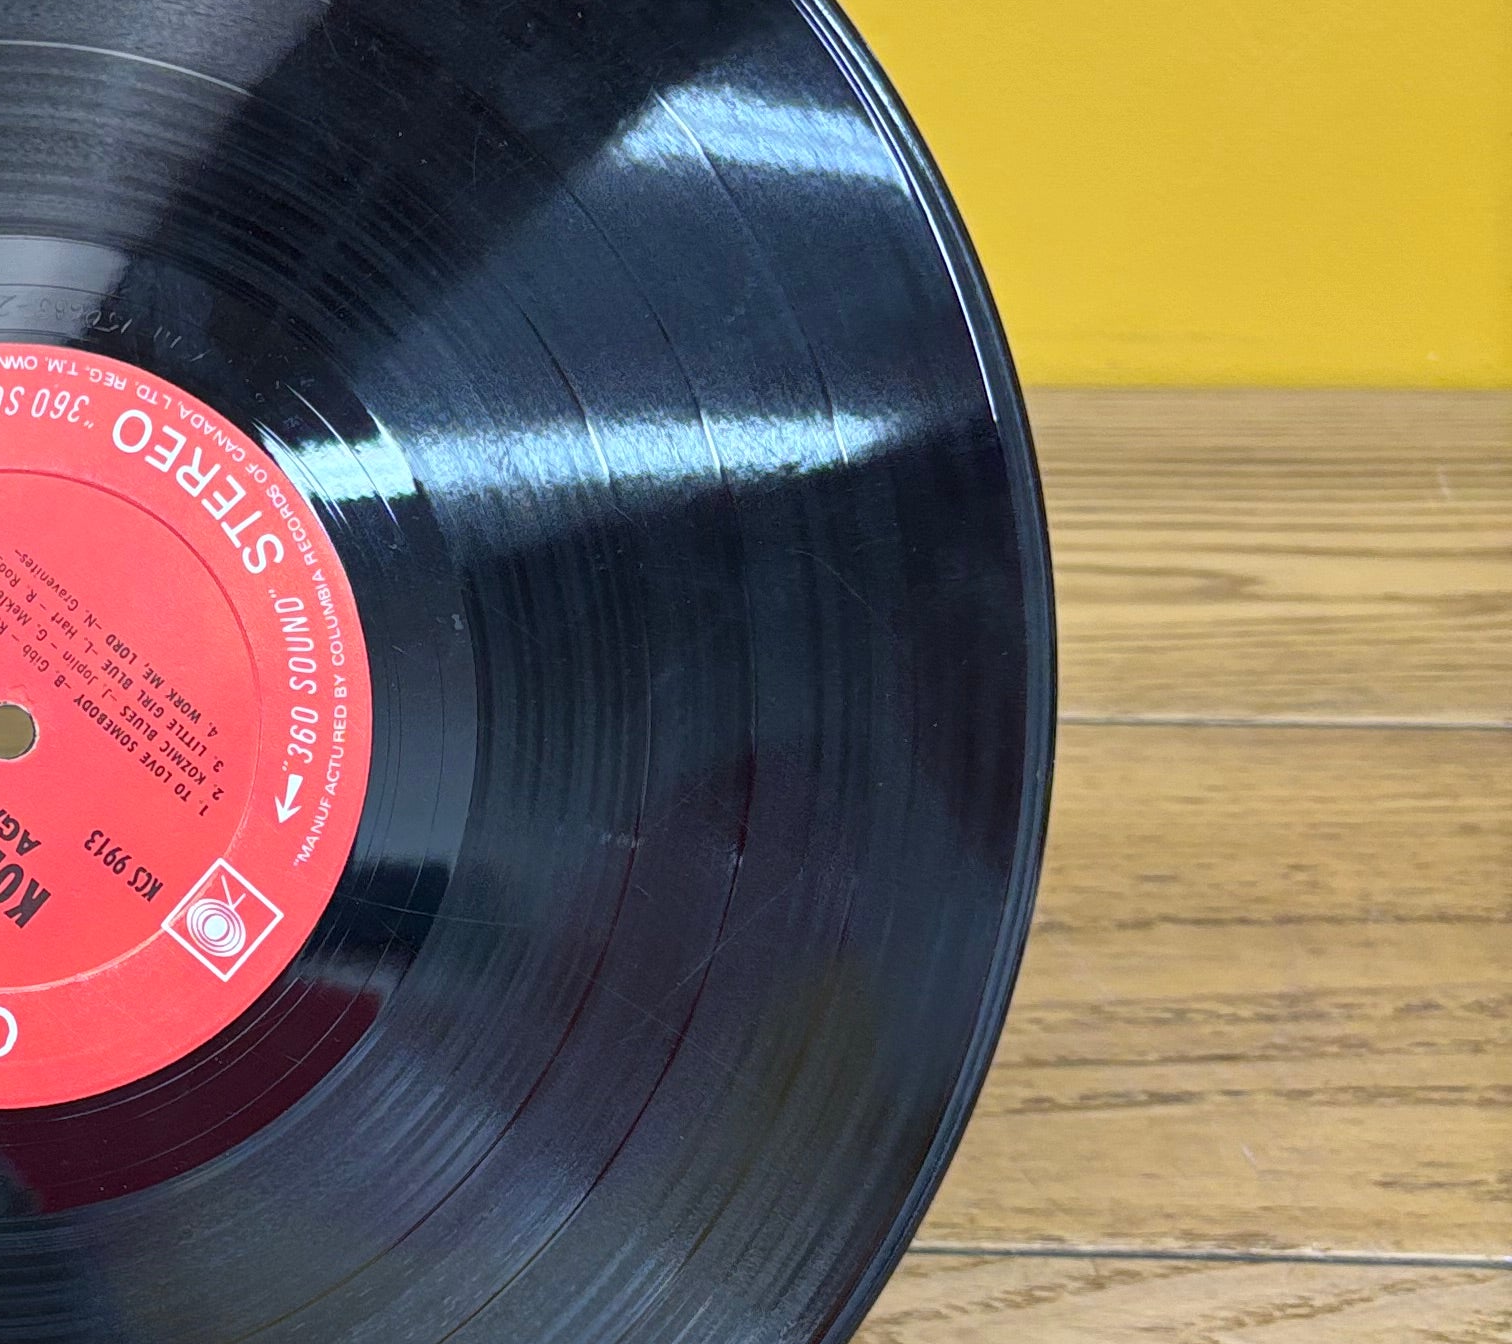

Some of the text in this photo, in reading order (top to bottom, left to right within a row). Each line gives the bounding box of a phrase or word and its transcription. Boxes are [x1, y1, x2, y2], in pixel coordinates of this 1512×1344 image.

[30, 388, 94, 429] "360
[177, 401, 246, 463] CANADA,
[244, 463, 268, 484] OF
[112, 409, 285, 574] STEREO
[265, 484, 318, 566] RECORDS
[25, 588, 38, 604] R.
[35, 623, 48, 642] G.
[50, 611, 79, 641] Hart
[311, 568, 345, 667] COLUMBIA
[22, 644, 50, 673] Gibb
[105, 633, 138, 665] LORD
[62, 650, 99, 686] Joplin
[100, 658, 134, 691] BLUE
[141, 662, 166, 690] ME,
[268, 588, 319, 772] "360 SOUND"
[333, 673, 348, 698] BY
[136, 689, 165, 719] GIRL
[165, 687, 202, 725] WORK
[72, 693, 139, 753] SOMEBODY
[119, 705, 159, 742] BLUES
[165, 717, 208, 758] LITTLE
[206, 721, 219, 738] 4.
[138, 751, 173, 784] LOVE
[158, 740, 207, 786] KOZMIC
[212, 755, 225, 773] 3.
[173, 782, 192, 803] TO
[198, 799, 209, 817] 1.
[211, 784, 225, 801] 2.
[83, 829, 164, 903] KCS 9913
